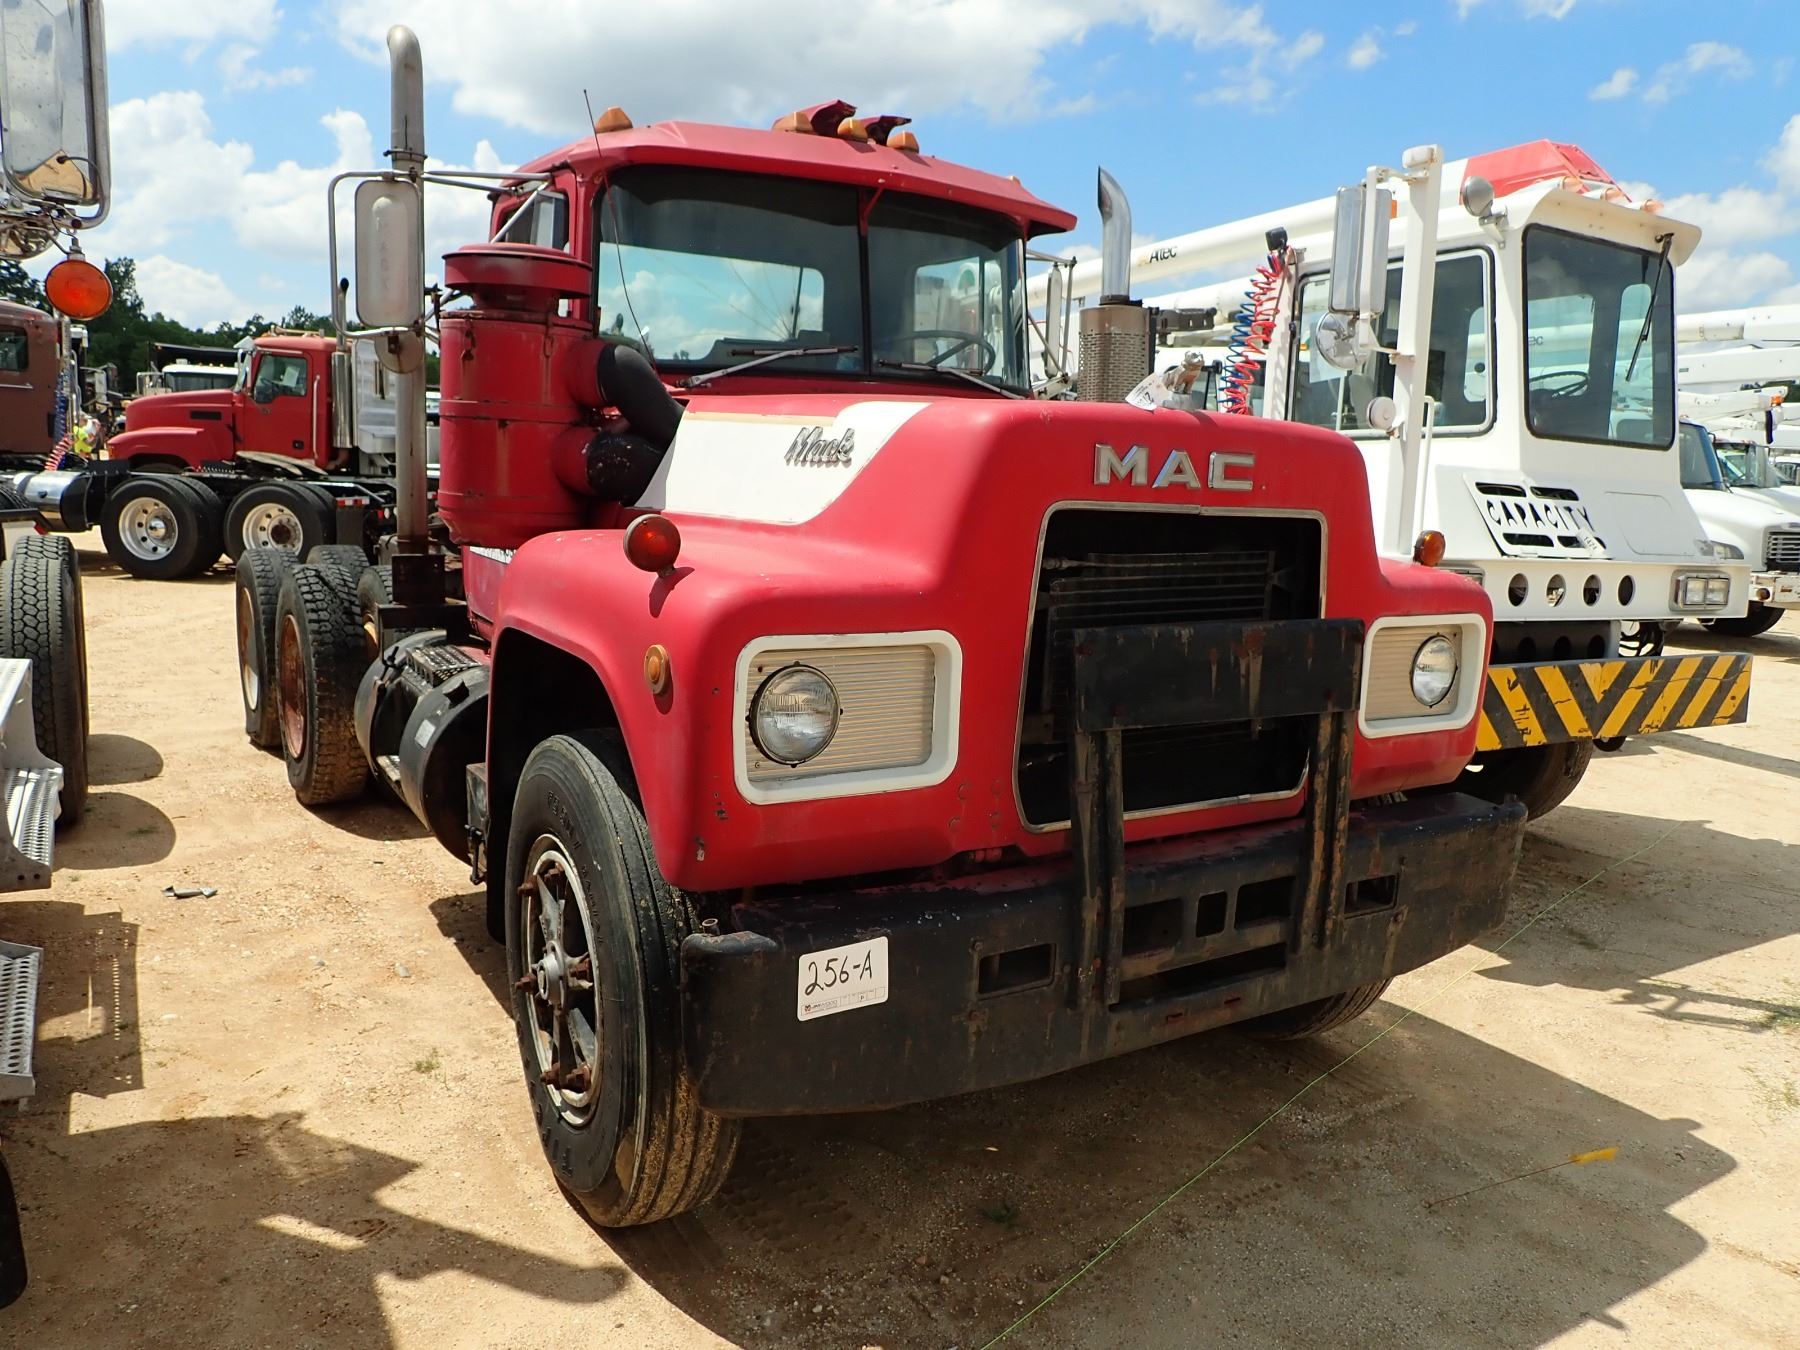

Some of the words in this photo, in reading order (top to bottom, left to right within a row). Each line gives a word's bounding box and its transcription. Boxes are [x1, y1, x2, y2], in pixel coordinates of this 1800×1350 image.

[784, 426, 855, 467] Mack
[1093, 443, 1255, 491] MAC
[1486, 499, 1595, 532] CAPACITY
[804, 949, 873, 996] 256-A
